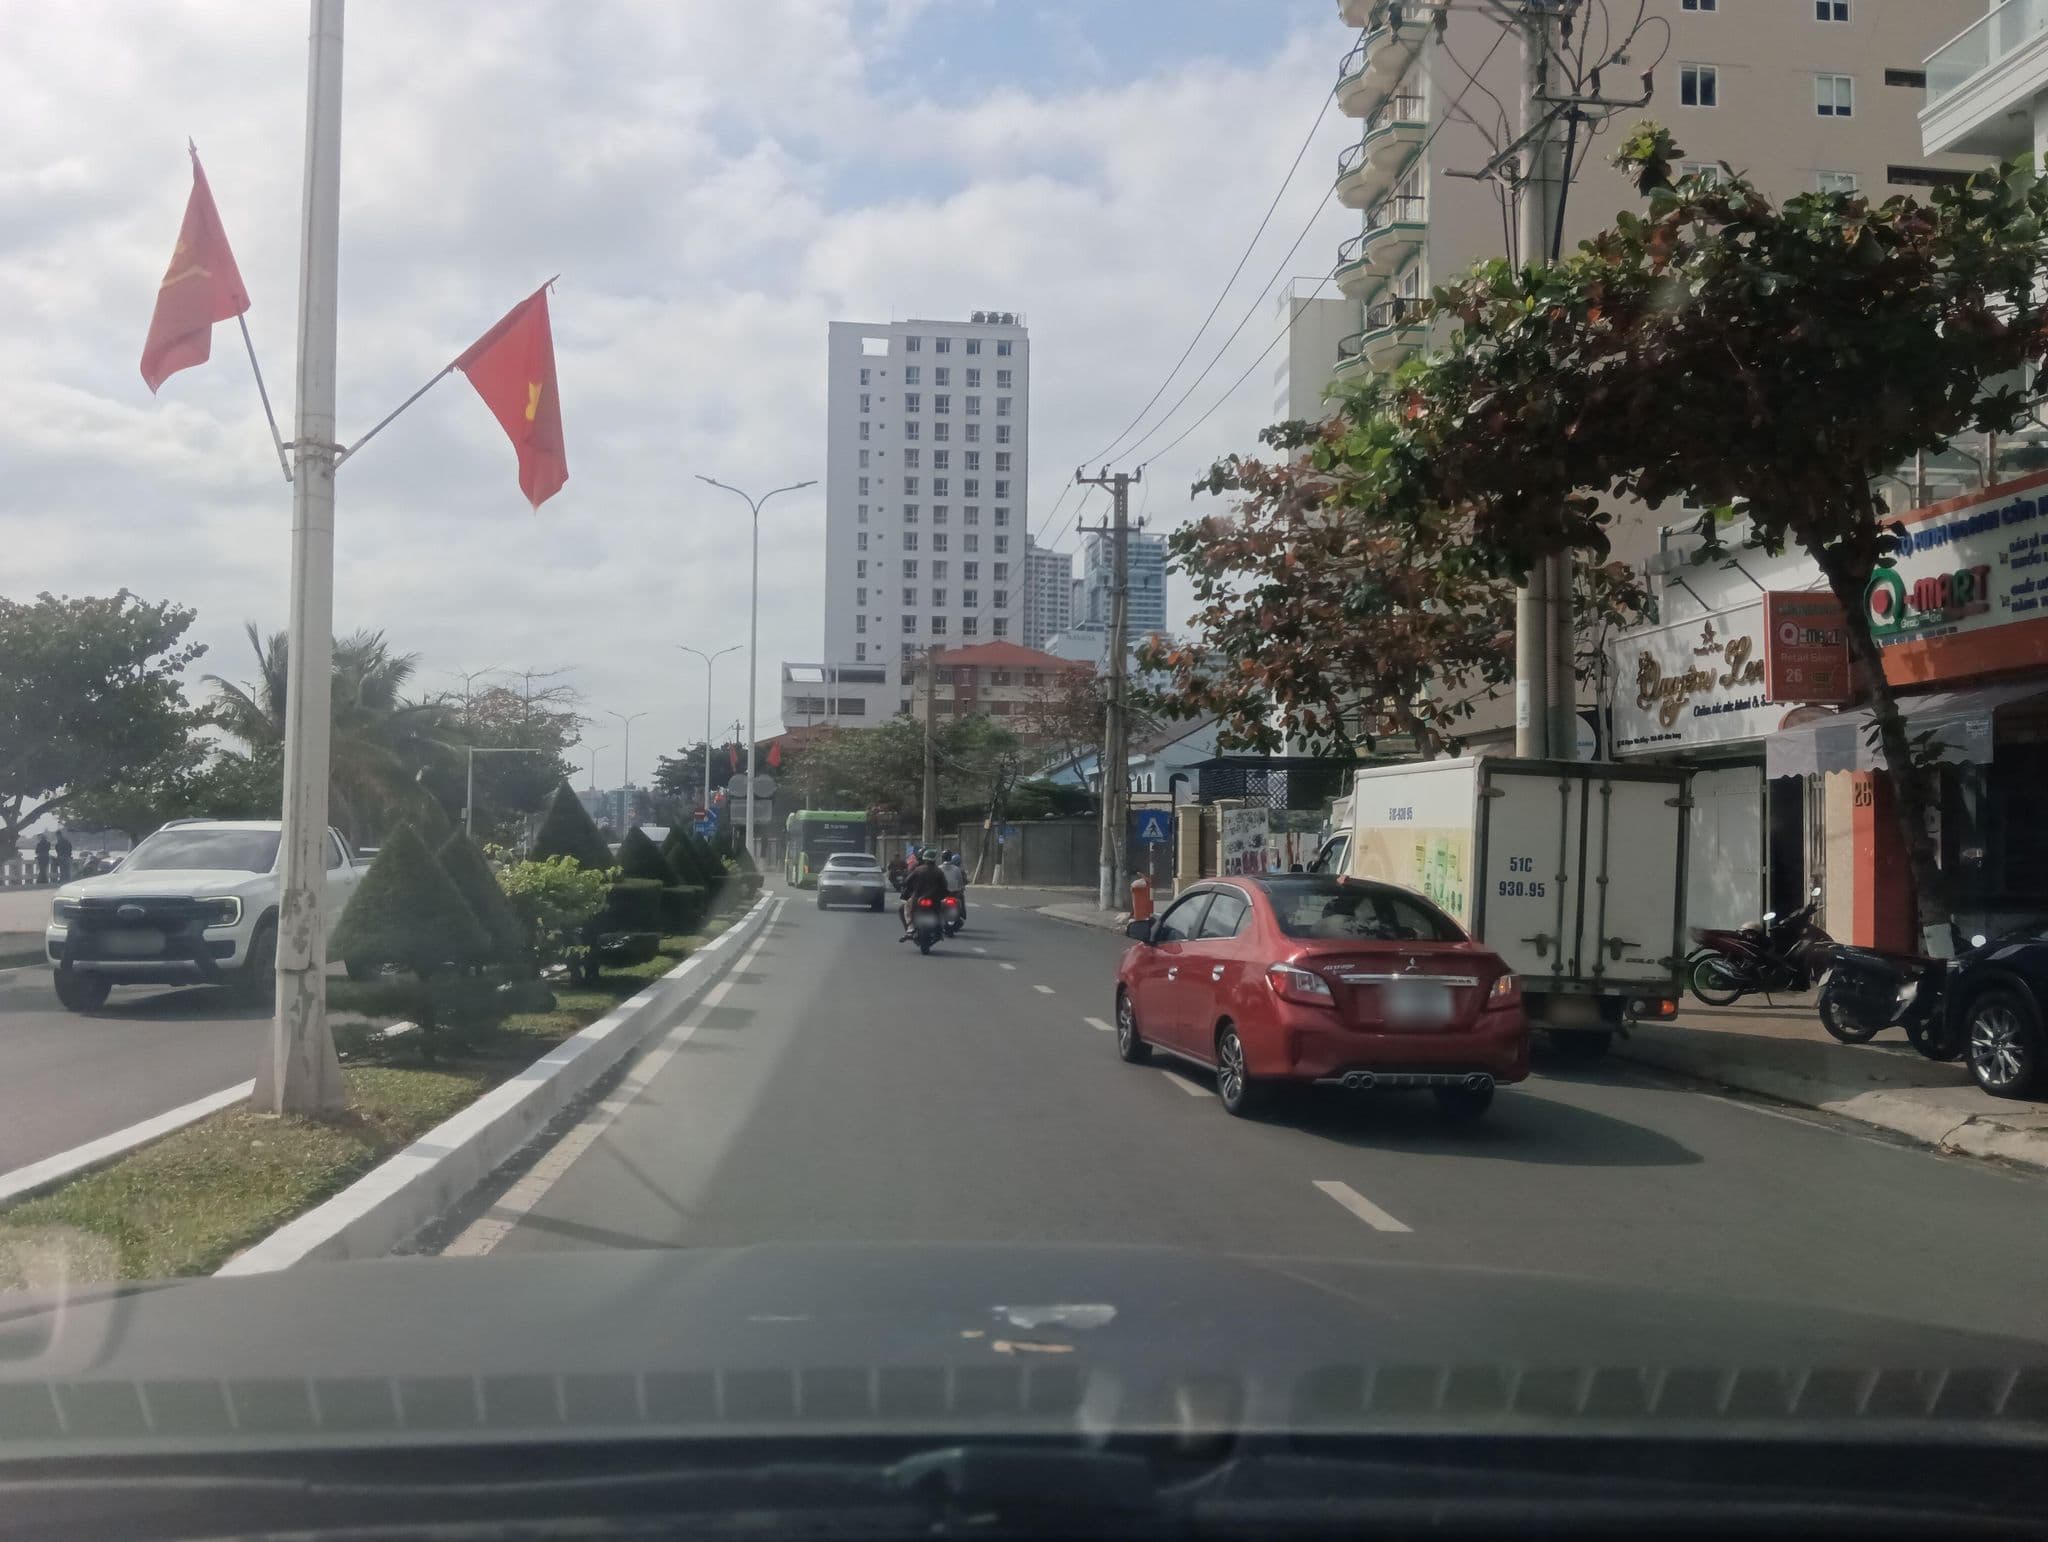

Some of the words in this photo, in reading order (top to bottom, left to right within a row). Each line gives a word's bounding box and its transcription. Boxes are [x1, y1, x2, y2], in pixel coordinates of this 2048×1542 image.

[1785, 667, 1803, 683] 26
[1509, 856, 1533, 873] 51C
[1498, 880, 1546, 898] 930.95
